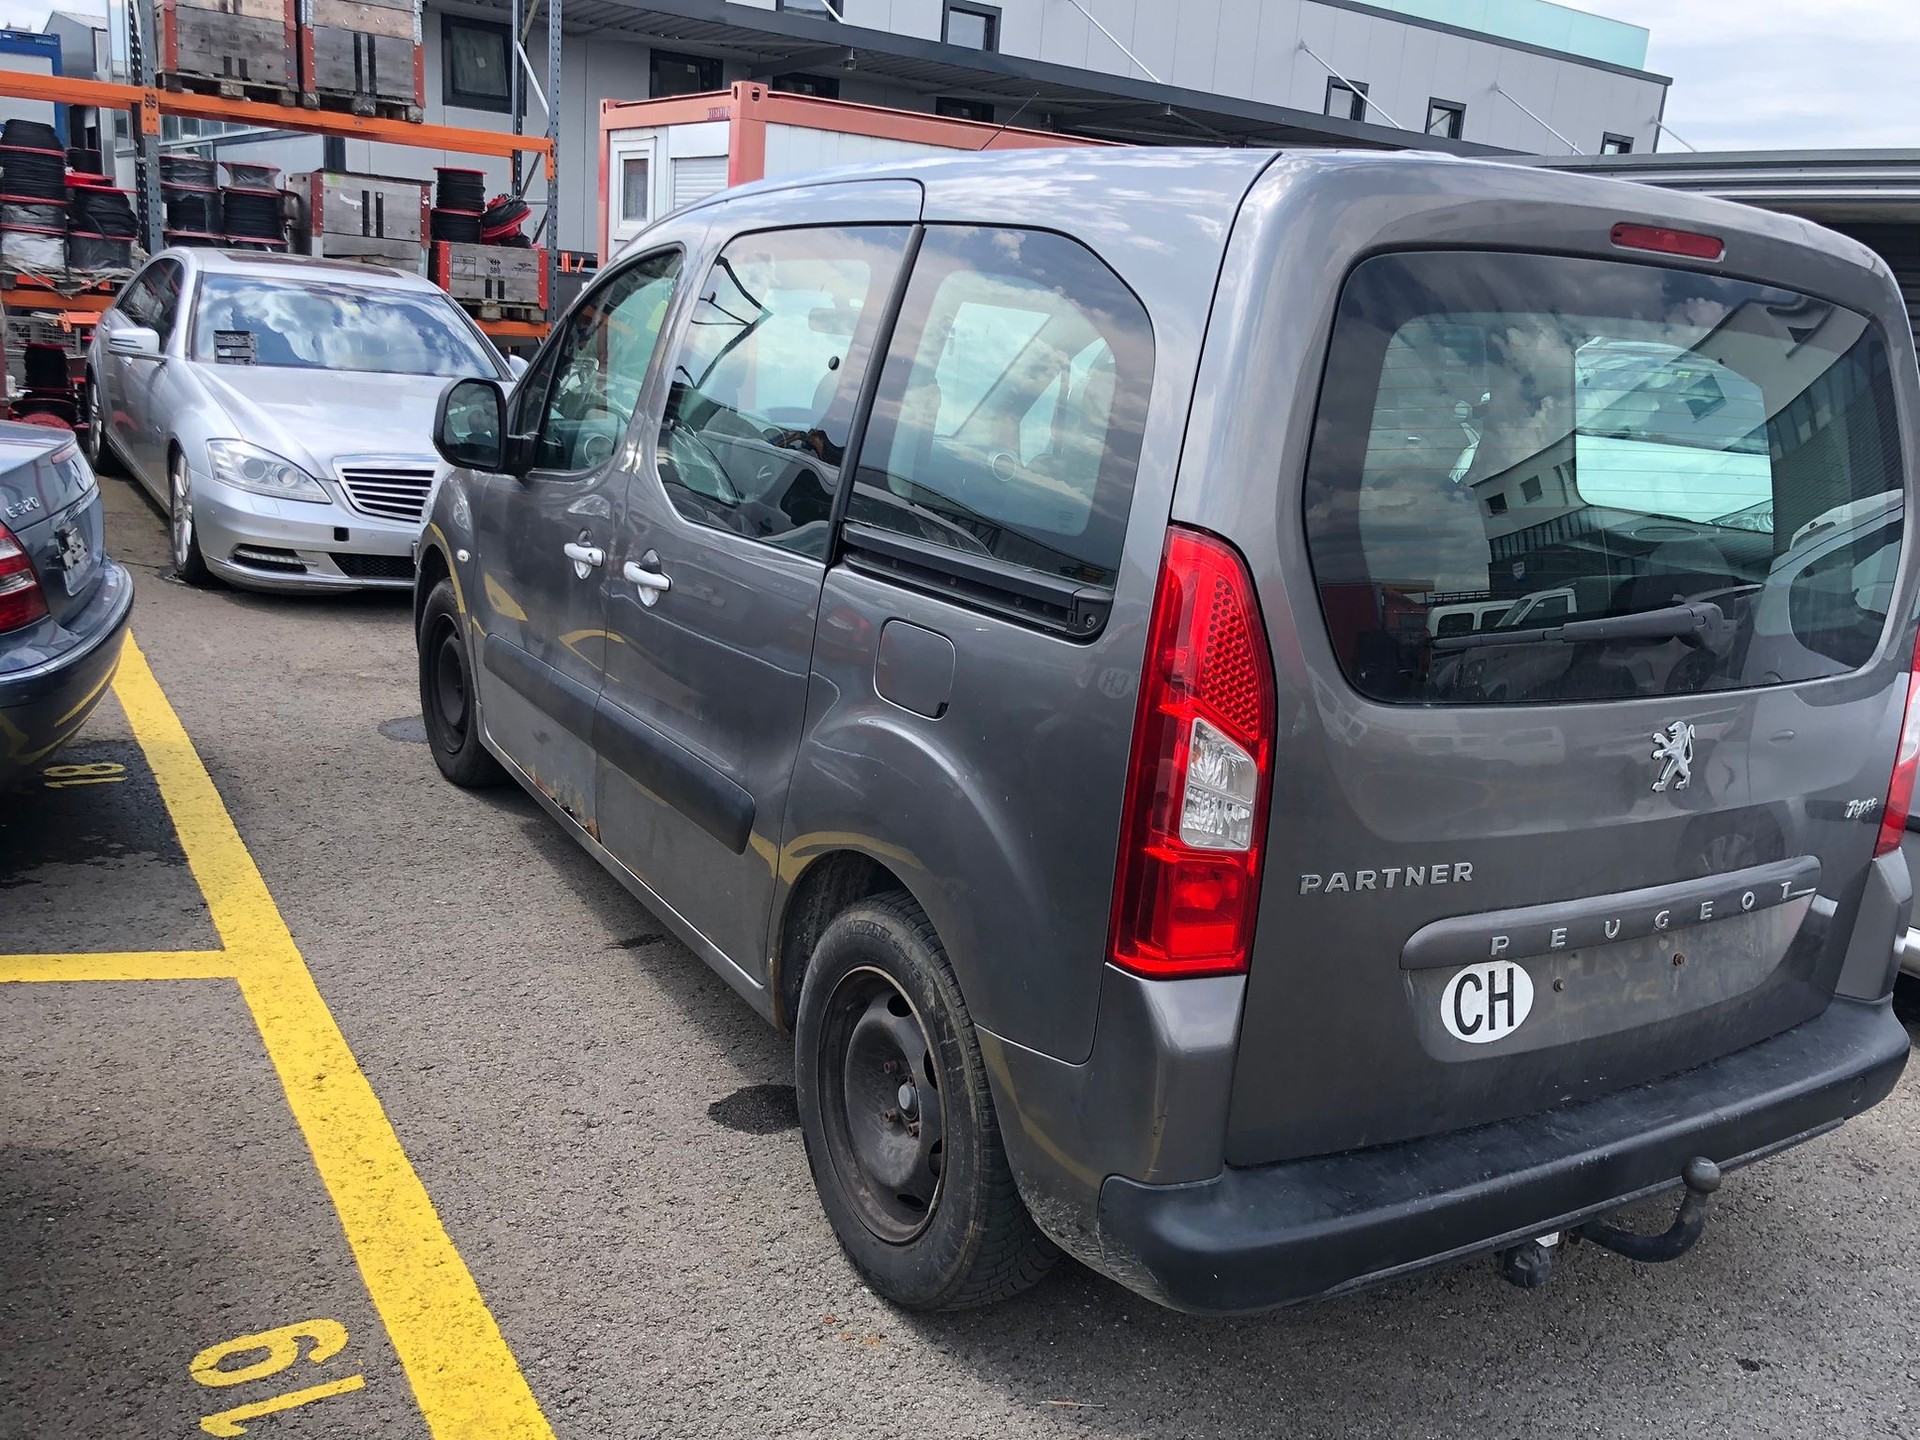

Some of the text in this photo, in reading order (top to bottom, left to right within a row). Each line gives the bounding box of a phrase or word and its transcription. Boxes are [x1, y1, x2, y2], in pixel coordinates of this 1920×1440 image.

[43, 762, 128, 788] 18
[1299, 862, 1474, 895] PARTNER
[1490, 880, 1793, 956] PEUGEOT
[1453, 967, 1515, 1036] CH
